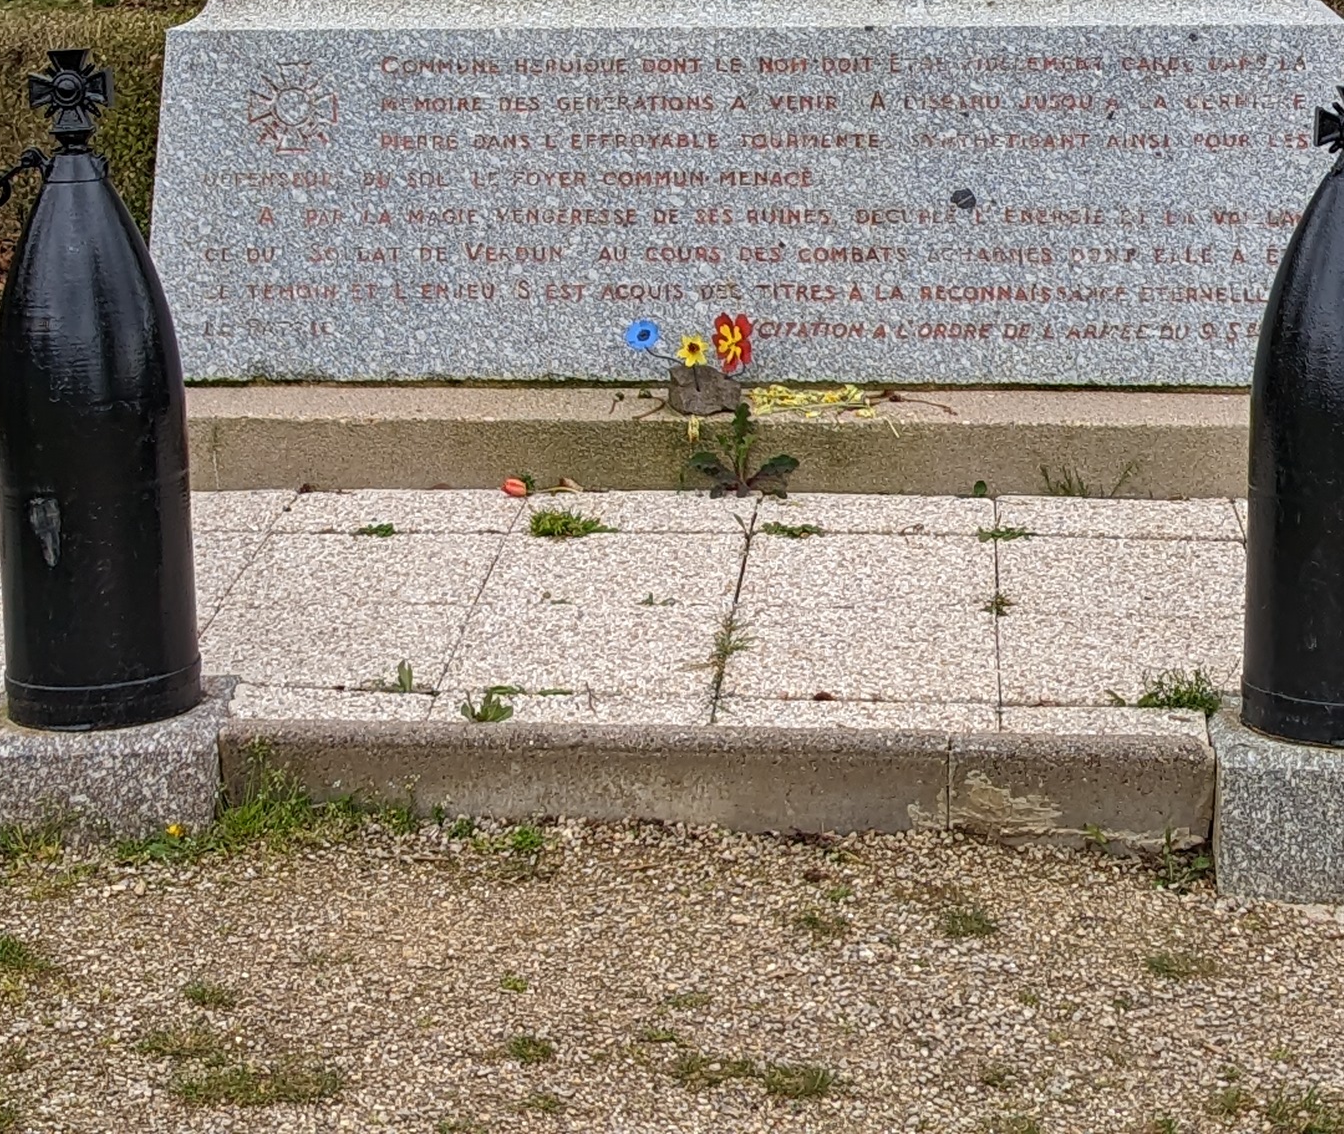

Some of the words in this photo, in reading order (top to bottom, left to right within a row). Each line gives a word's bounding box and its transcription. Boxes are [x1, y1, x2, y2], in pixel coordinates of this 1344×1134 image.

[381, 56, 499, 75] COMMUNE
[642, 58, 701, 74] DONT
[716, 57, 742, 73] LE
[759, 57, 808, 74] NOM
[822, 56, 874, 74] DOIT
[498, 97, 540, 112] DES
[770, 96, 837, 111] VENIR
[870, 92, 886, 110] A
[474, 134, 531, 150] DANS
[1107, 133, 1170, 149] AINSI
[1194, 133, 1250, 149] POUR
[1268, 133, 1309, 149] LES
[513, 171, 586, 187] FOYER
[258, 207, 274, 224] A
[363, 209, 391, 225] LA
[408, 209, 479, 226] MAGIE
[654, 209, 678, 225] DE
[695, 209, 734, 225] SES
[419, 247, 447, 262] DE
[465, 243, 563, 263] VERDUN
[598, 247, 628, 262] AU
[646, 247, 721, 263] COURS
[739, 247, 782, 263] DES
[798, 247, 907, 263] COMBATS
[1230, 246, 1246, 263] A
[602, 284, 684, 301] ACQUIS
[756, 284, 835, 301] TITRES
[875, 284, 904, 300] LA
[1003, 323, 1032, 338] DE
